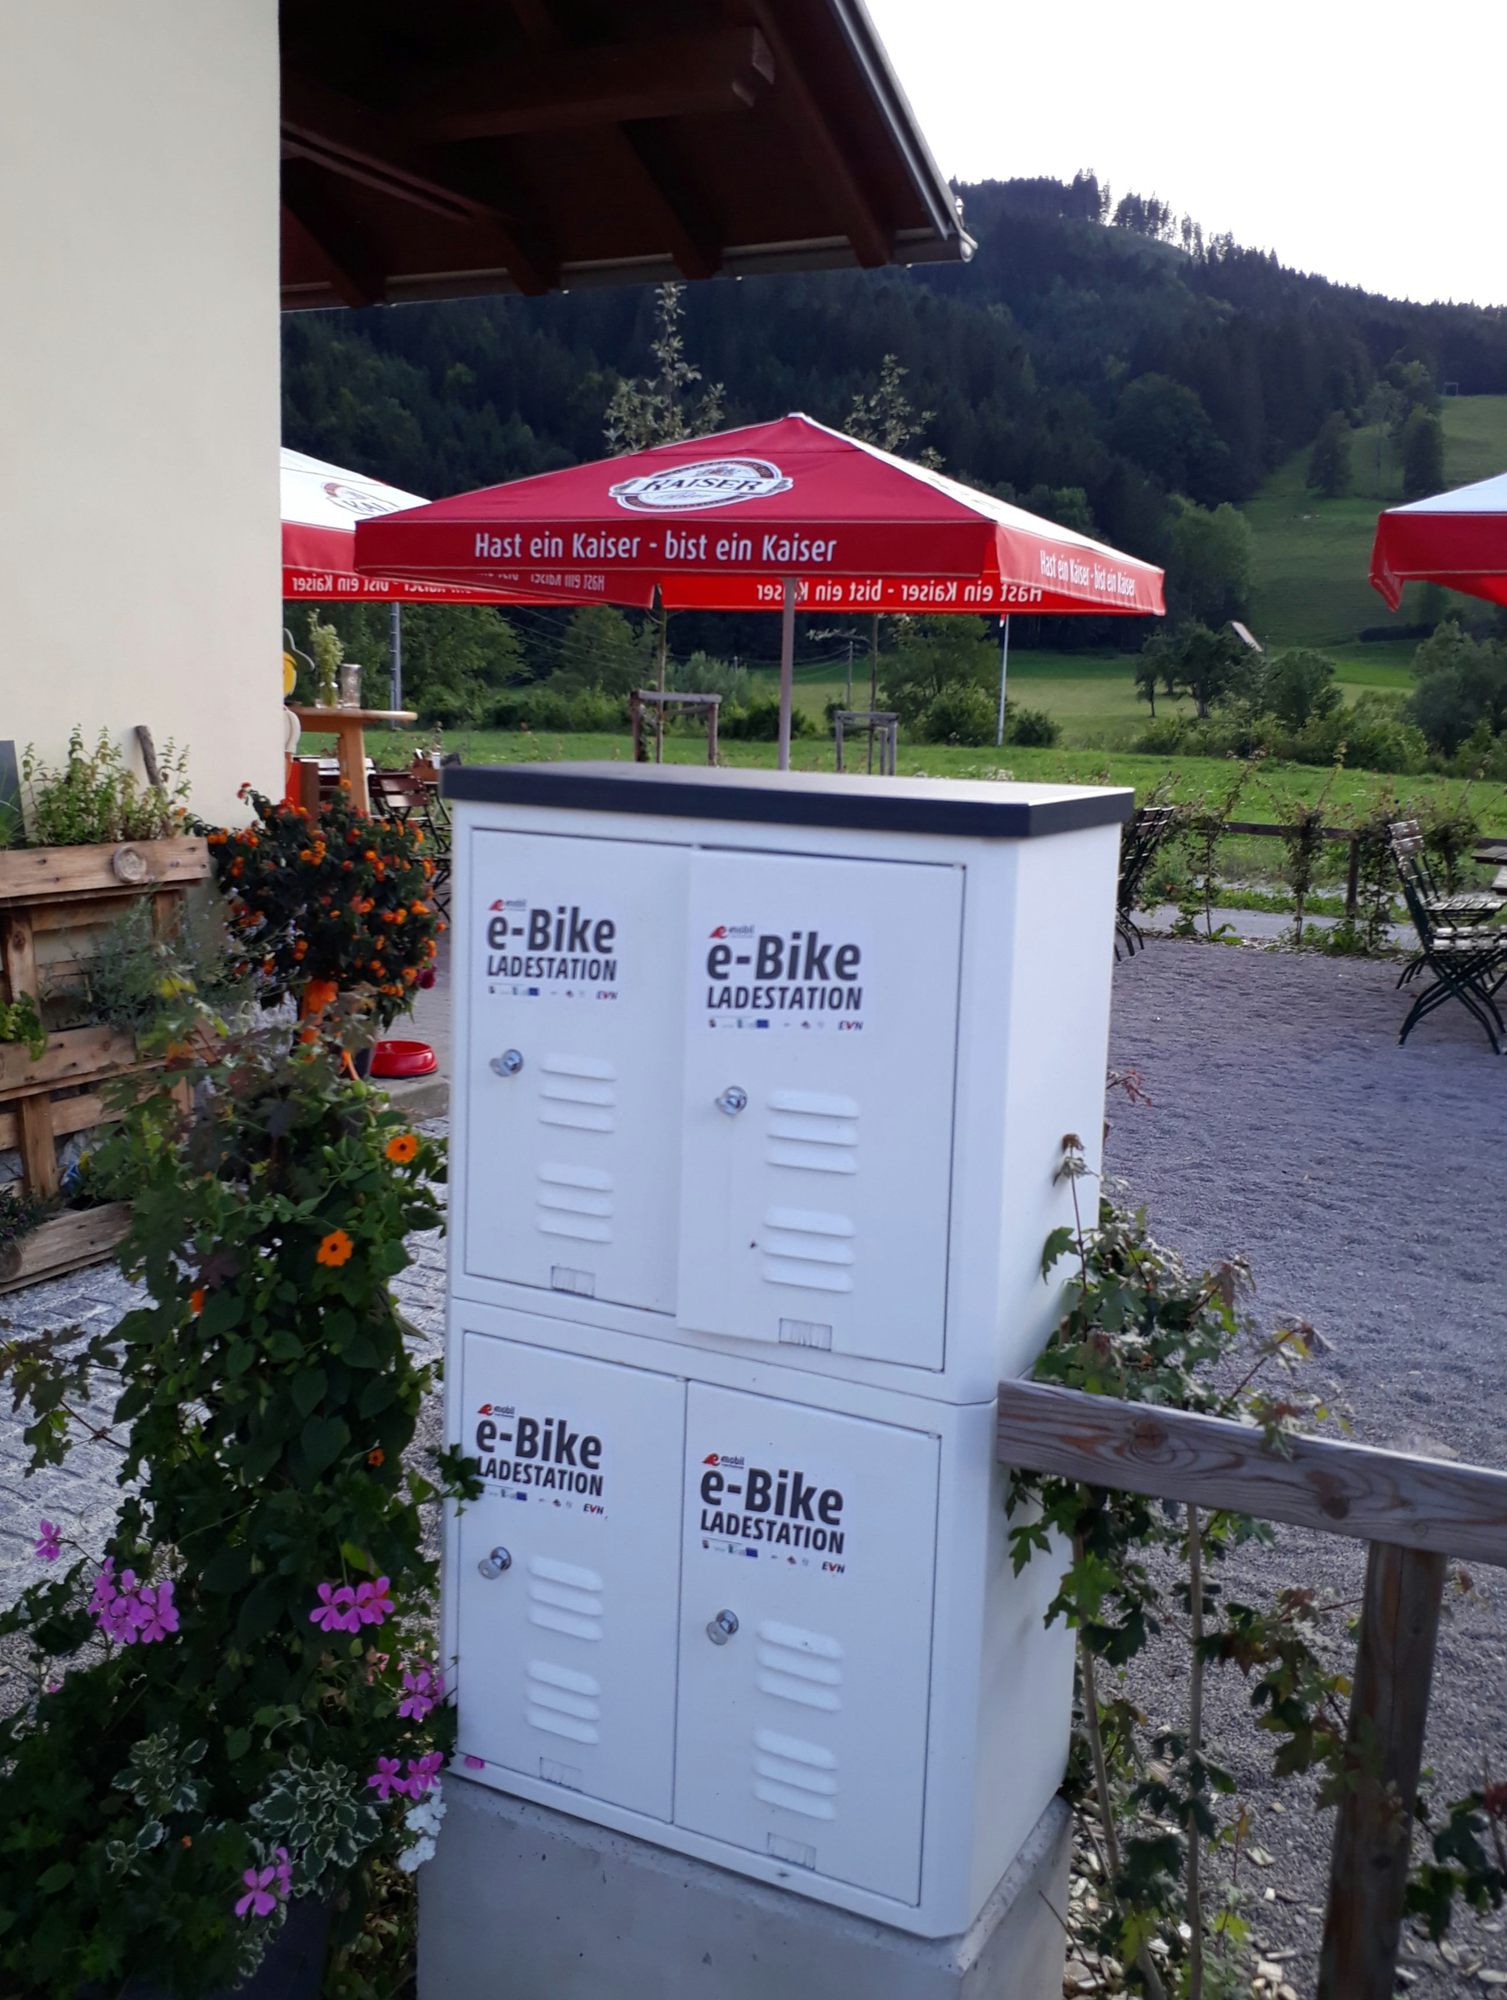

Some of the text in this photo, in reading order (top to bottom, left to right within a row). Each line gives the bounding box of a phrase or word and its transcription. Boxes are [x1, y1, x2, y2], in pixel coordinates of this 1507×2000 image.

[640, 478, 763, 491] KAISER
[474, 532, 522, 558] Hast
[530, 530, 563, 558] ein
[572, 530, 641, 558] Kaiser
[665, 529, 708, 560] bist
[716, 532, 752, 561] ein
[762, 533, 837, 562] Kaiser
[1040, 549, 1056, 578] Hast
[1057, 554, 1069, 582] ein
[1070, 558, 1089, 587] Kaiser
[1094, 563, 1106, 591] bist
[1107, 568, 1117, 593] ein
[1118, 571, 1135, 597] Kaiser
[487, 906, 616, 954] e-Bike
[487, 955, 617, 981] LADESTATION
[706, 931, 861, 981] e-Bike
[706, 985, 863, 1010] LADESTATION
[838, 1020, 863, 1031] EVN
[476, 1416, 602, 1470] e-Bike
[476, 1456, 604, 1497] LADESTATION
[583, 1503, 604, 1515] EVN
[700, 1467, 844, 1526] e-Bike
[701, 1508, 845, 1555] LADESTATION
[822, 1561, 846, 1574] EVN
